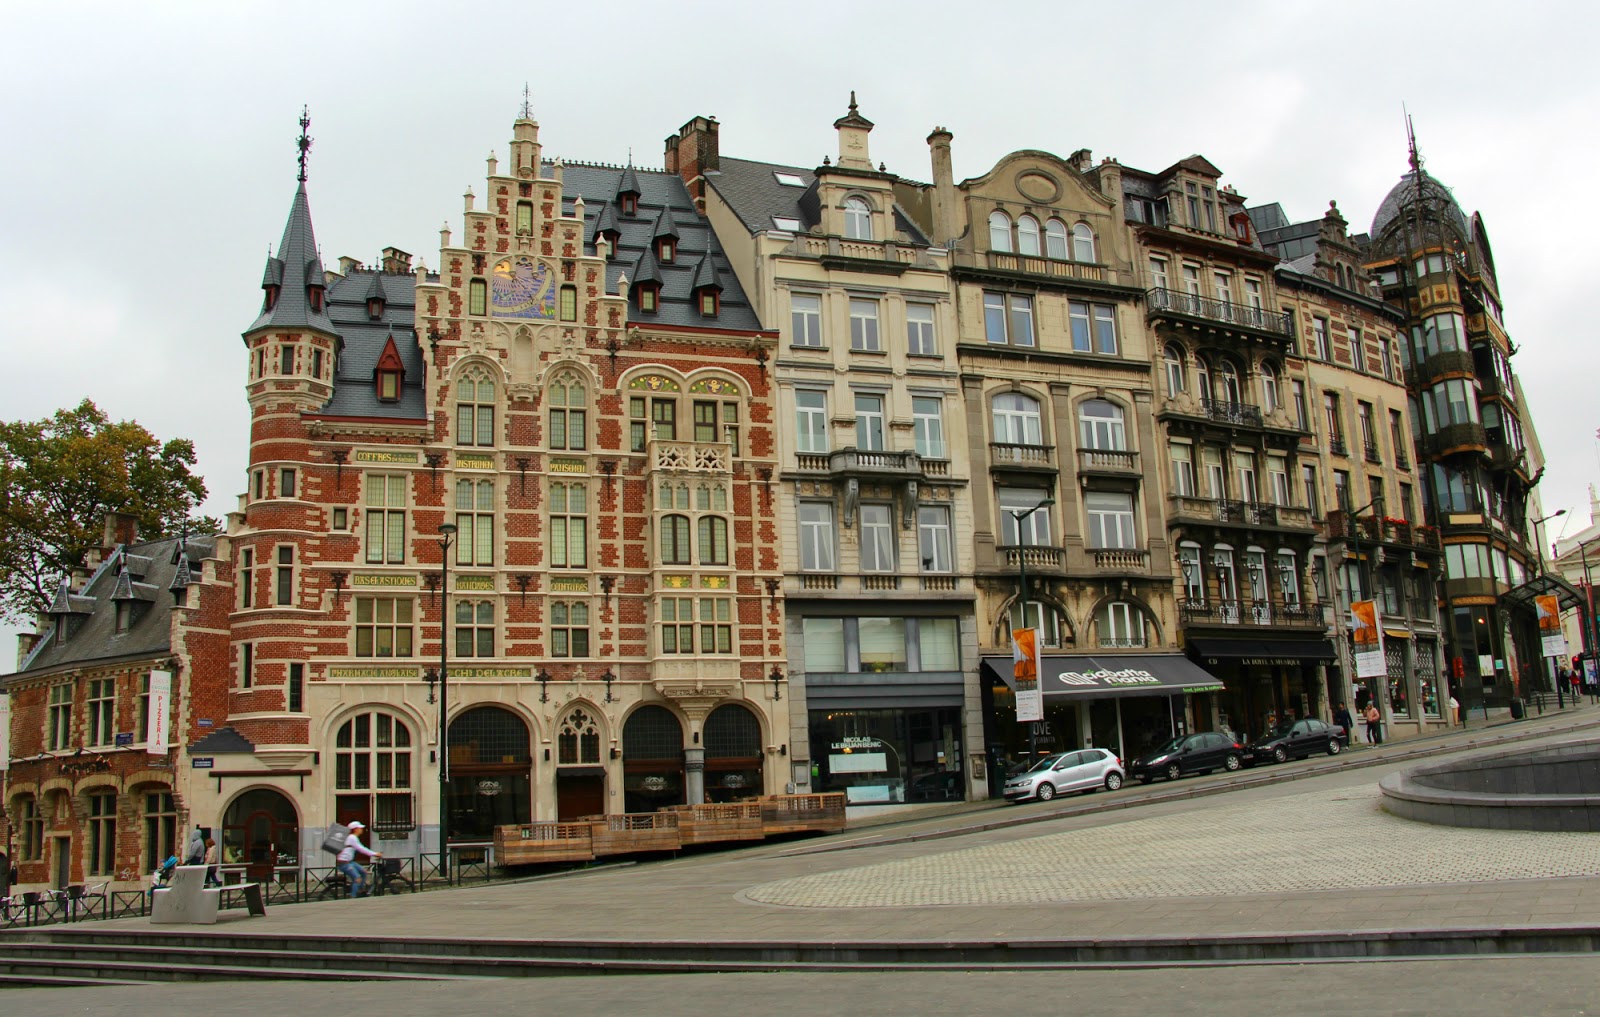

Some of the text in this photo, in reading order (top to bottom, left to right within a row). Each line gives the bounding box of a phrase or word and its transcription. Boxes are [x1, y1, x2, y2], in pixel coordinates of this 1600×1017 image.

[357, 452, 392, 462] COFFRES
[331, 668, 418, 677] PHARMACIE ANGLAISE
[475, 668, 523, 677] DELACRE
[1082, 667, 1152, 680] ciabatta
[1104, 675, 1159, 684] mania
